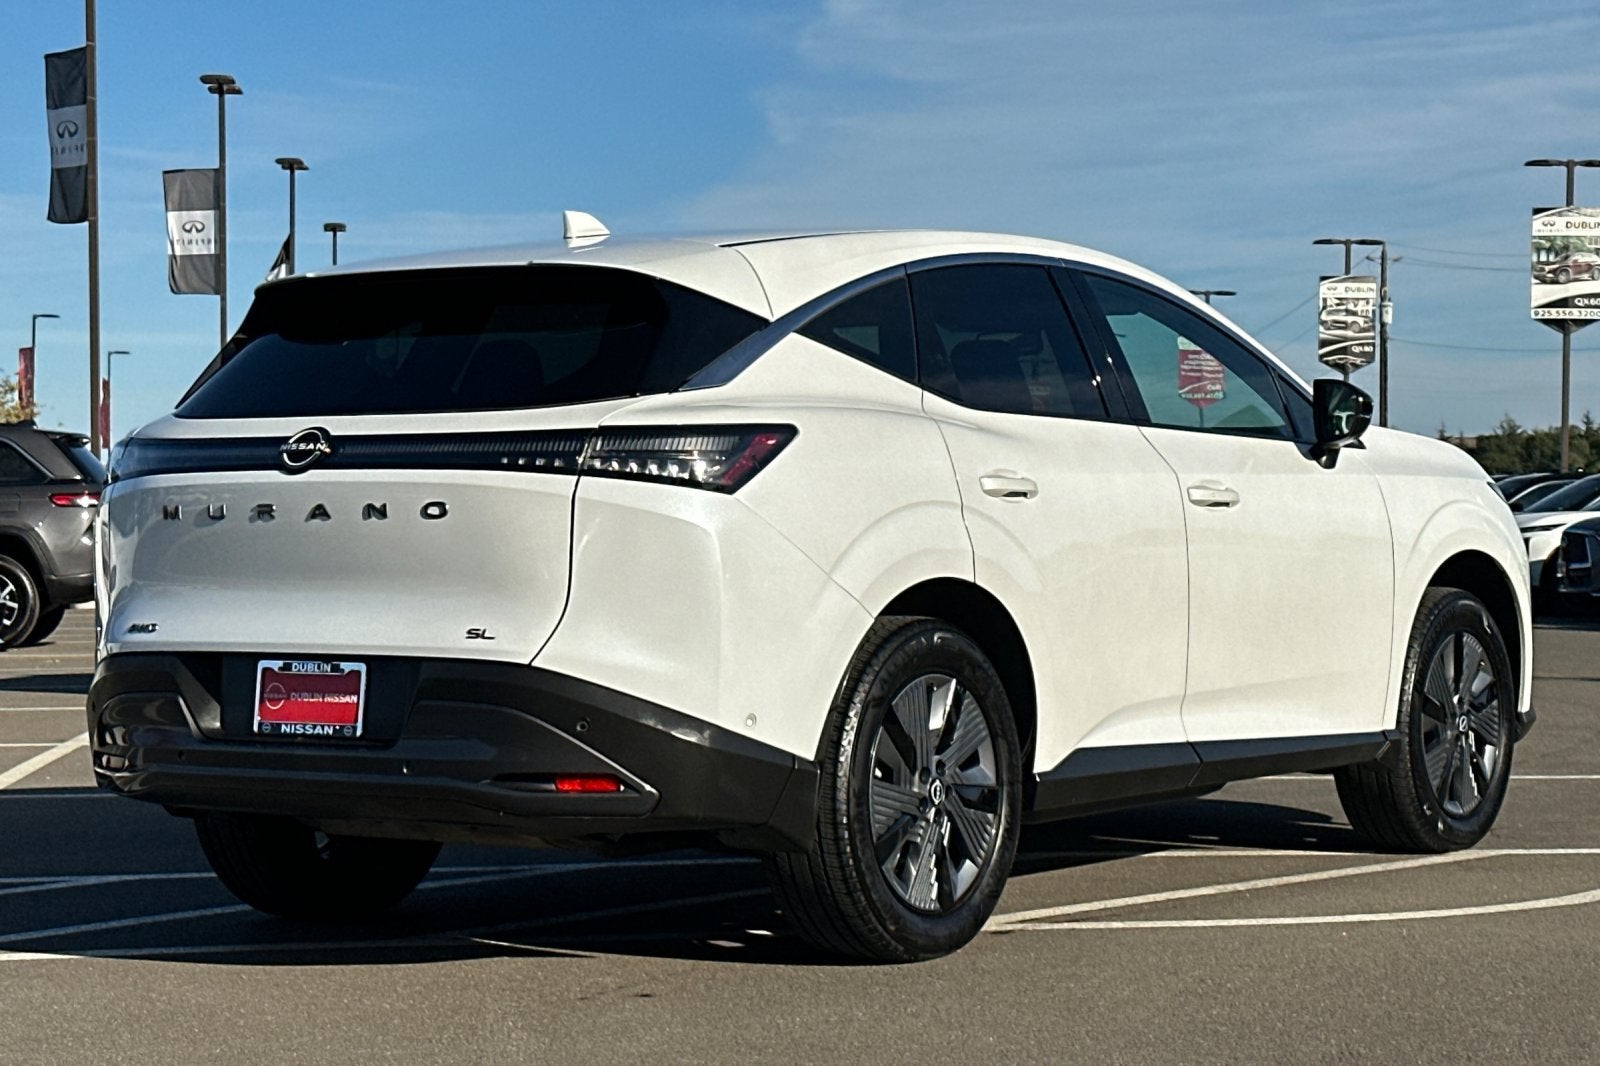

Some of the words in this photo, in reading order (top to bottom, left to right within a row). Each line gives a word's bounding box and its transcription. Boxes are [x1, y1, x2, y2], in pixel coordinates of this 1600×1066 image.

[279, 442, 326, 451] NISSAN
[162, 501, 449, 520] MURANO
[465, 628, 496, 640] SL
[291, 662, 331, 673] DUBLIN
[290, 691, 322, 702] DUBLIN
[324, 693, 358, 704] NISSAN
[281, 724, 334, 735] NISSAN
